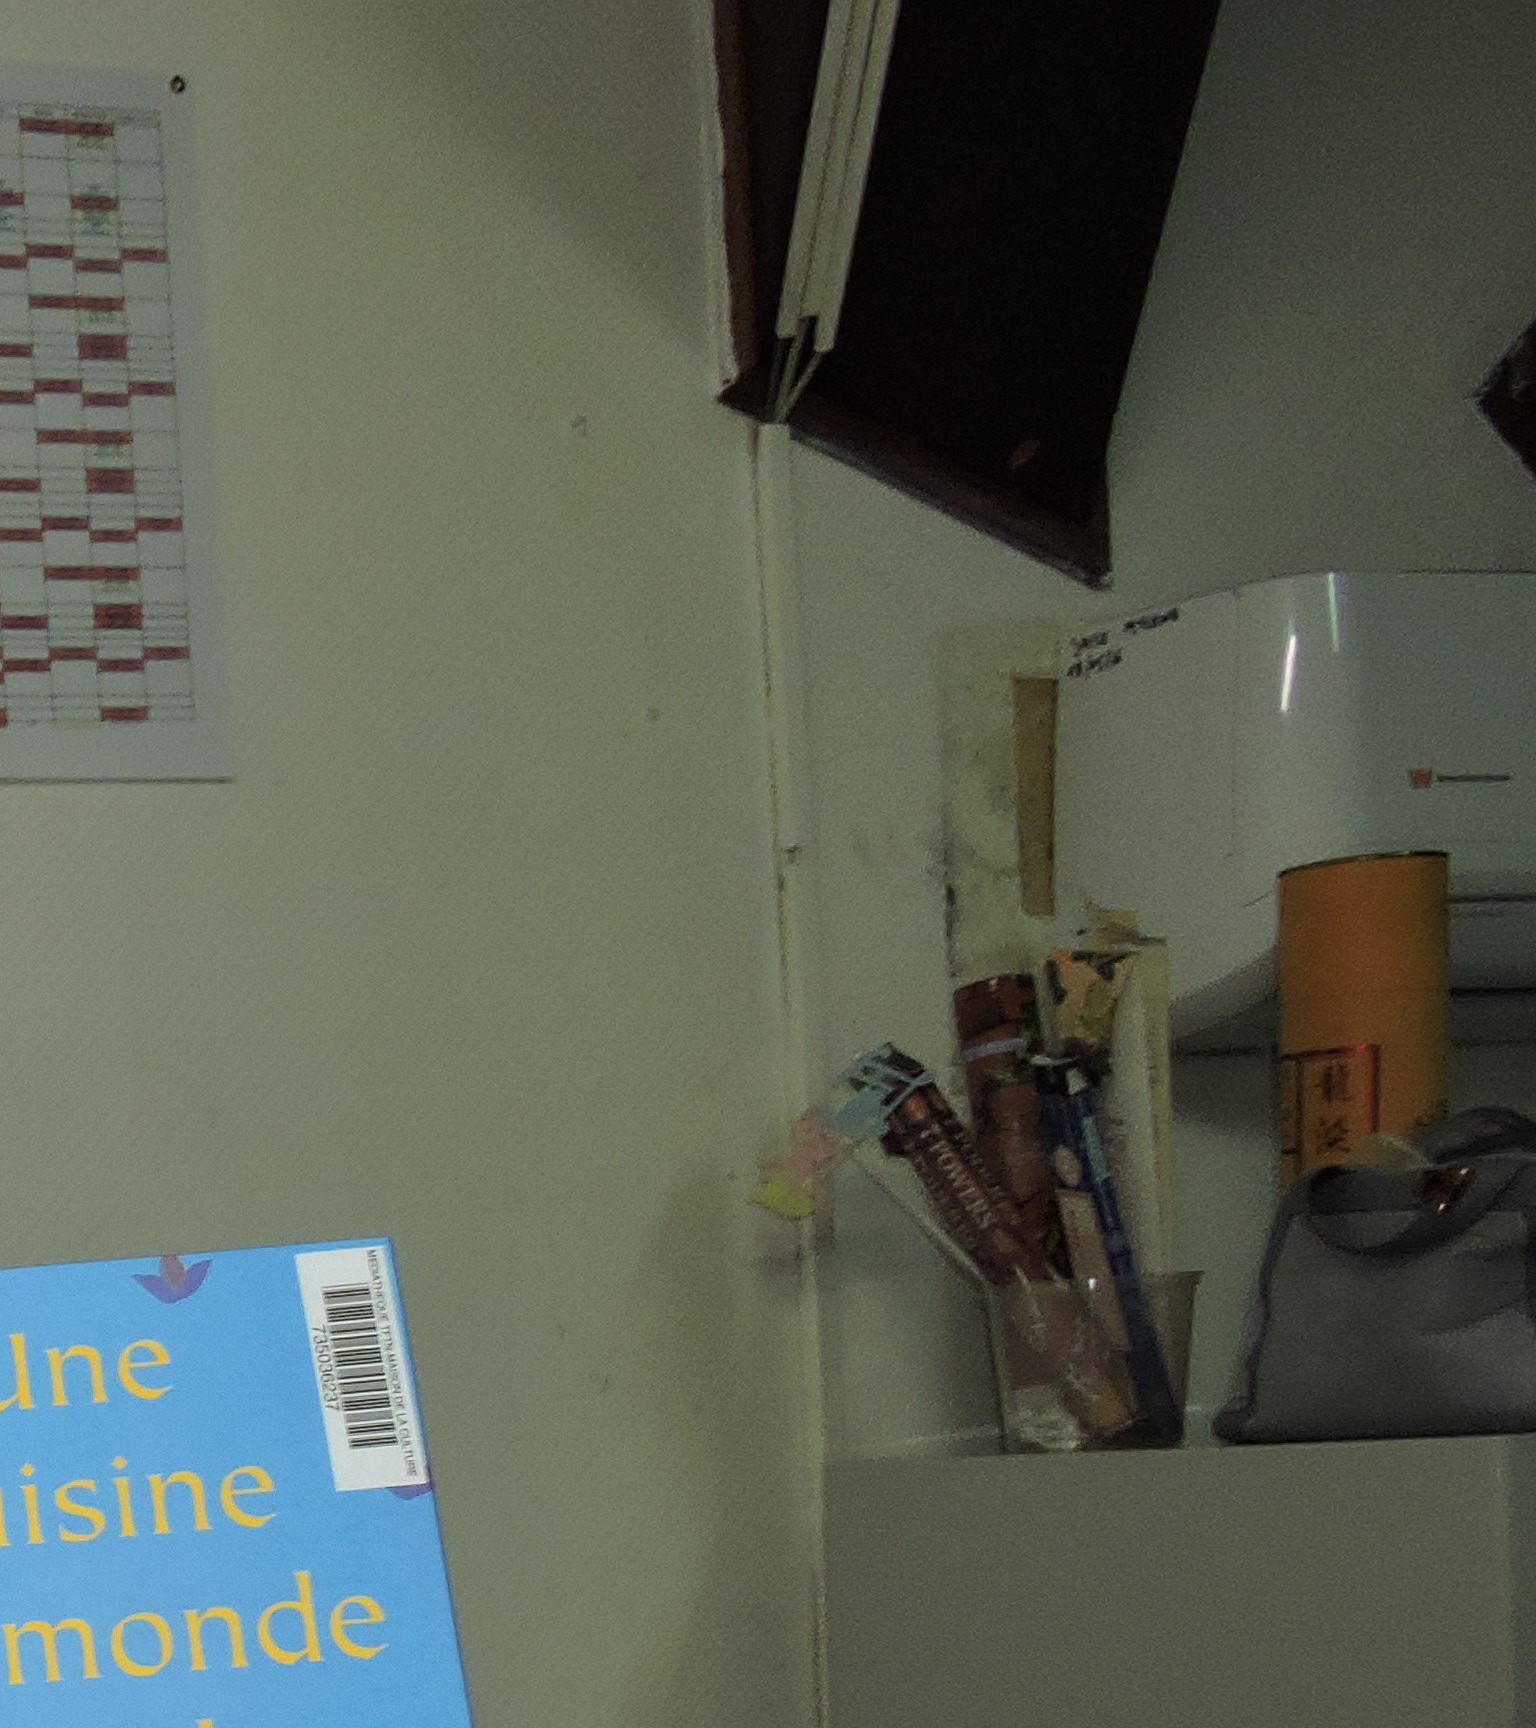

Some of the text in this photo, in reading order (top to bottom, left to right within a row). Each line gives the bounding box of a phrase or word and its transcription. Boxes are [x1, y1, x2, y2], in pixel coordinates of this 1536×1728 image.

[311, 1325, 340, 1412] 735036237
[398, 1427, 417, 1477] CULTURE
[3, 1570, 384, 1685] monde
